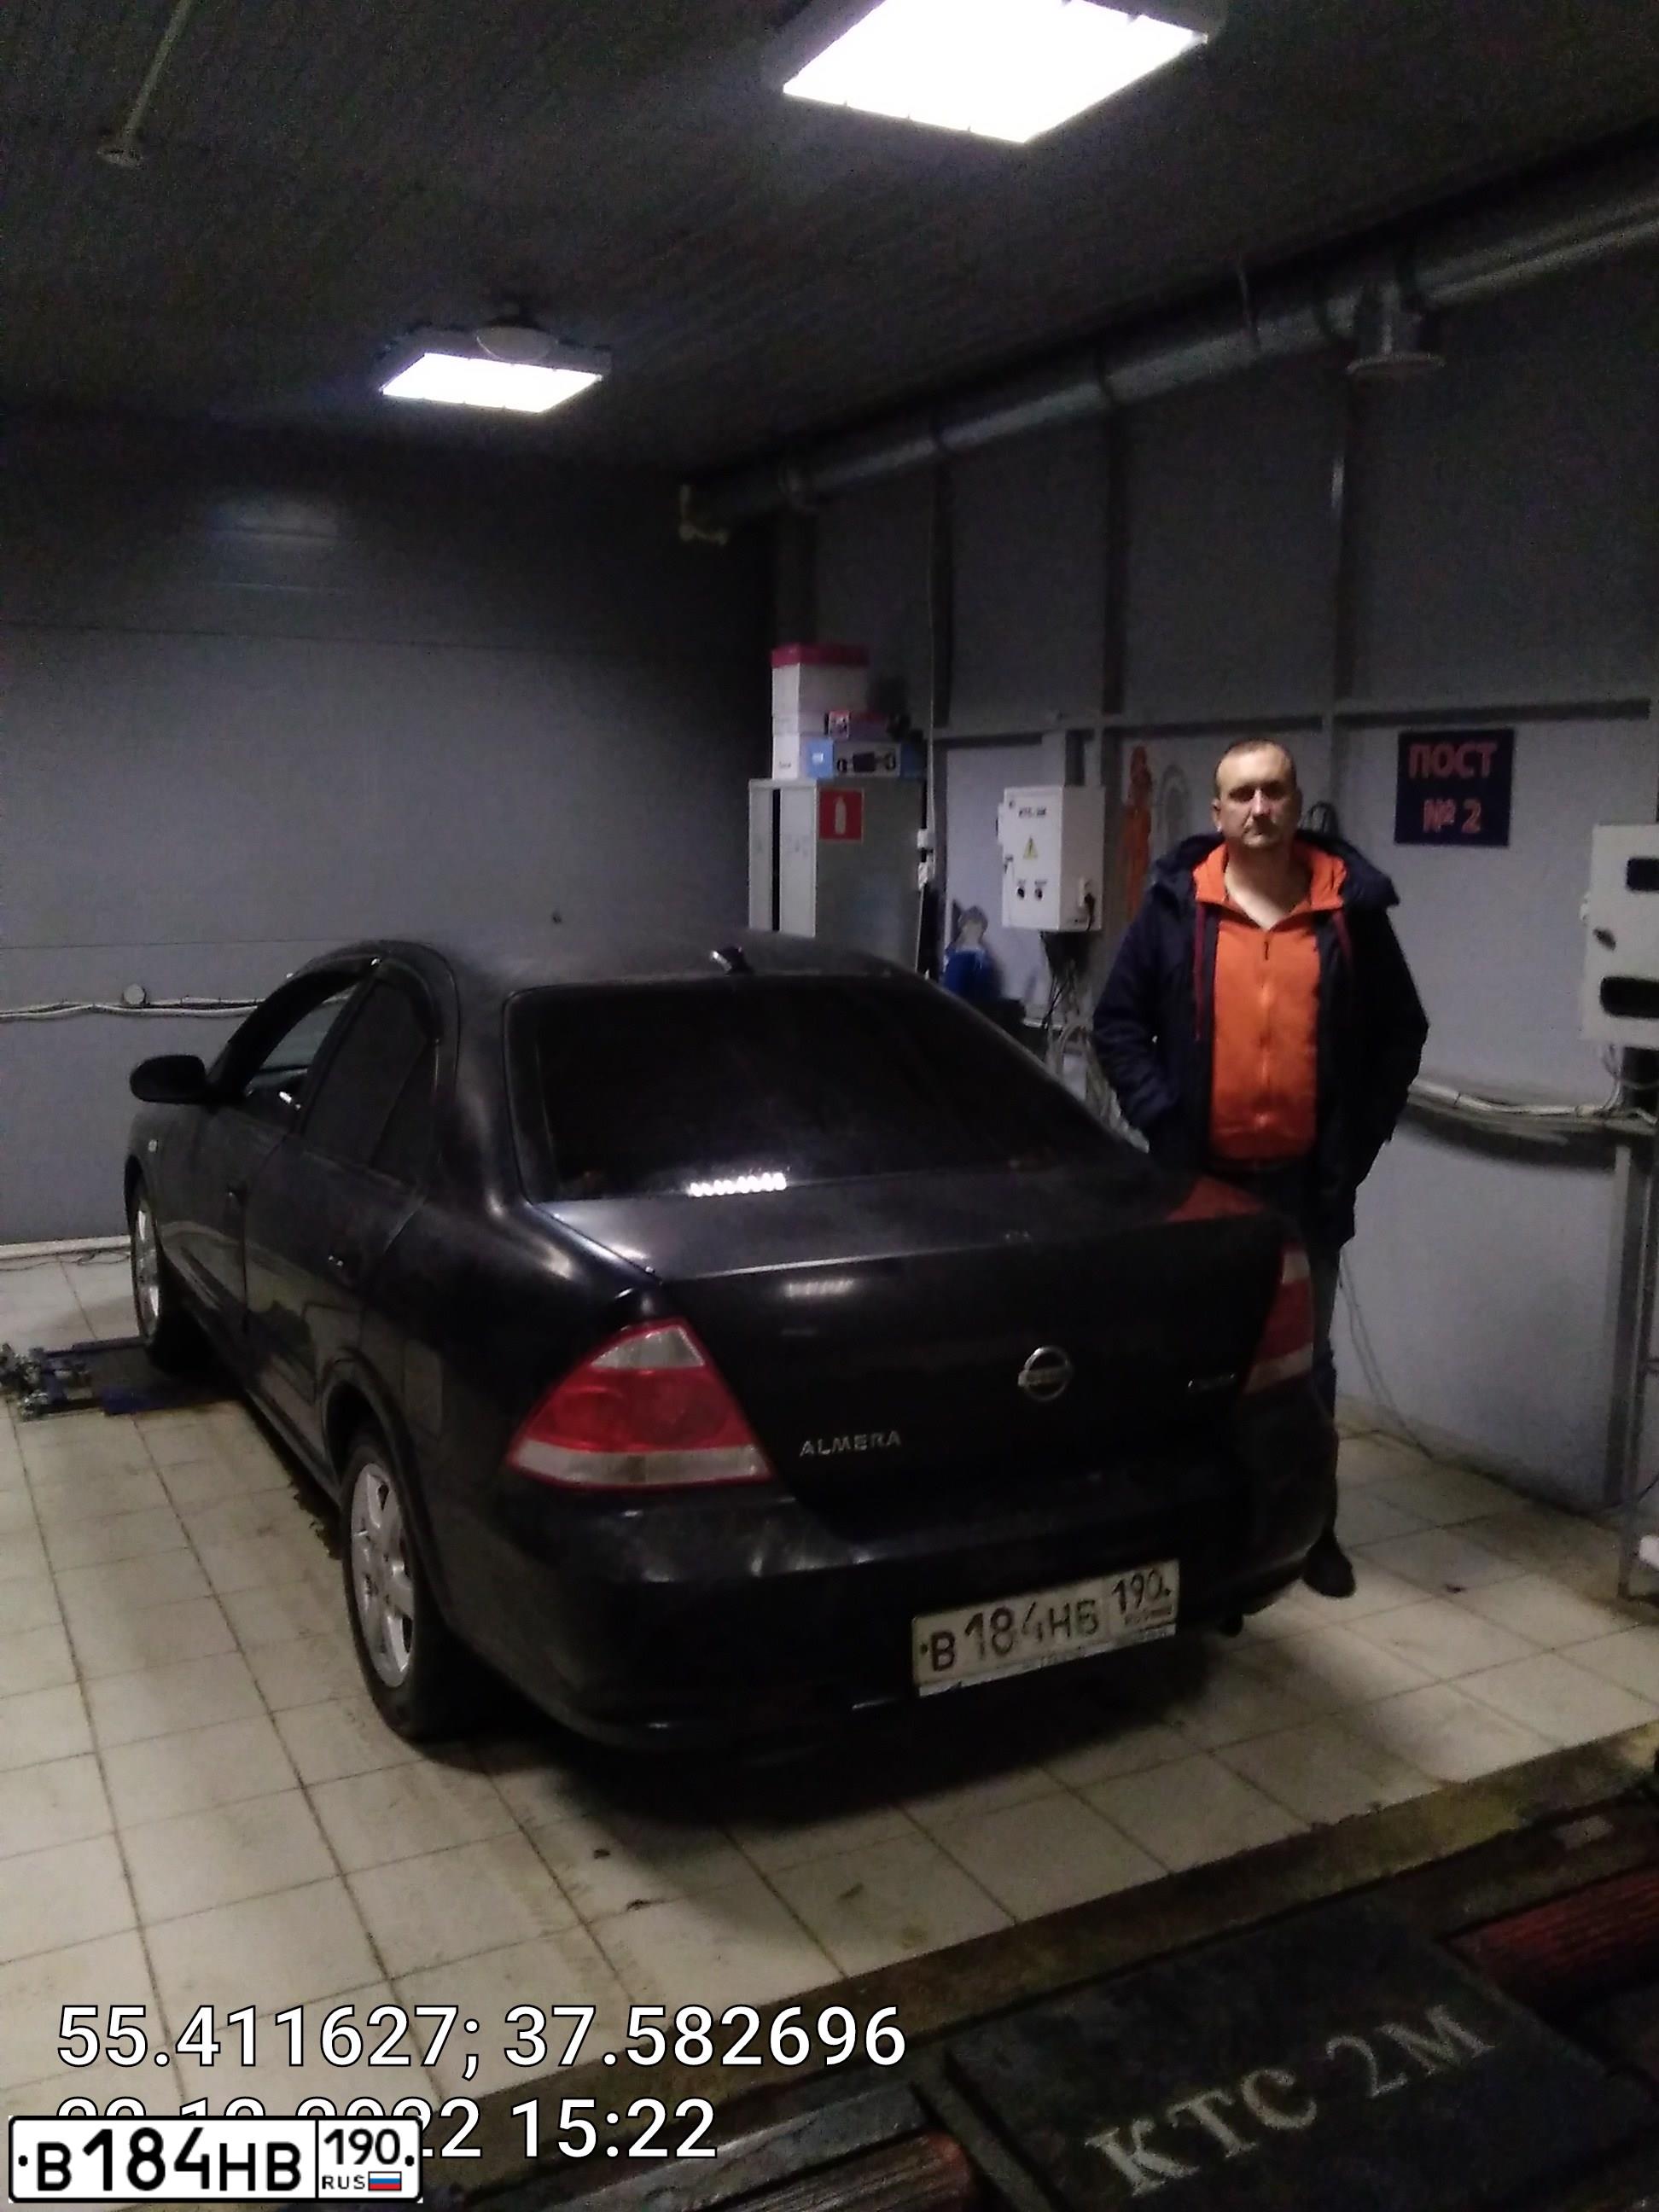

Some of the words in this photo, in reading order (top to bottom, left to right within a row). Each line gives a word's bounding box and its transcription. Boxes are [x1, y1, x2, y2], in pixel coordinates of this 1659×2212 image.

[1408, 742, 1499, 780] ПОСТ
[1423, 798, 1457, 834] №
[1462, 798, 1482, 834] 2
[800, 1430, 902, 1457] ALMERA
[1112, 1569, 1164, 1615] 190
